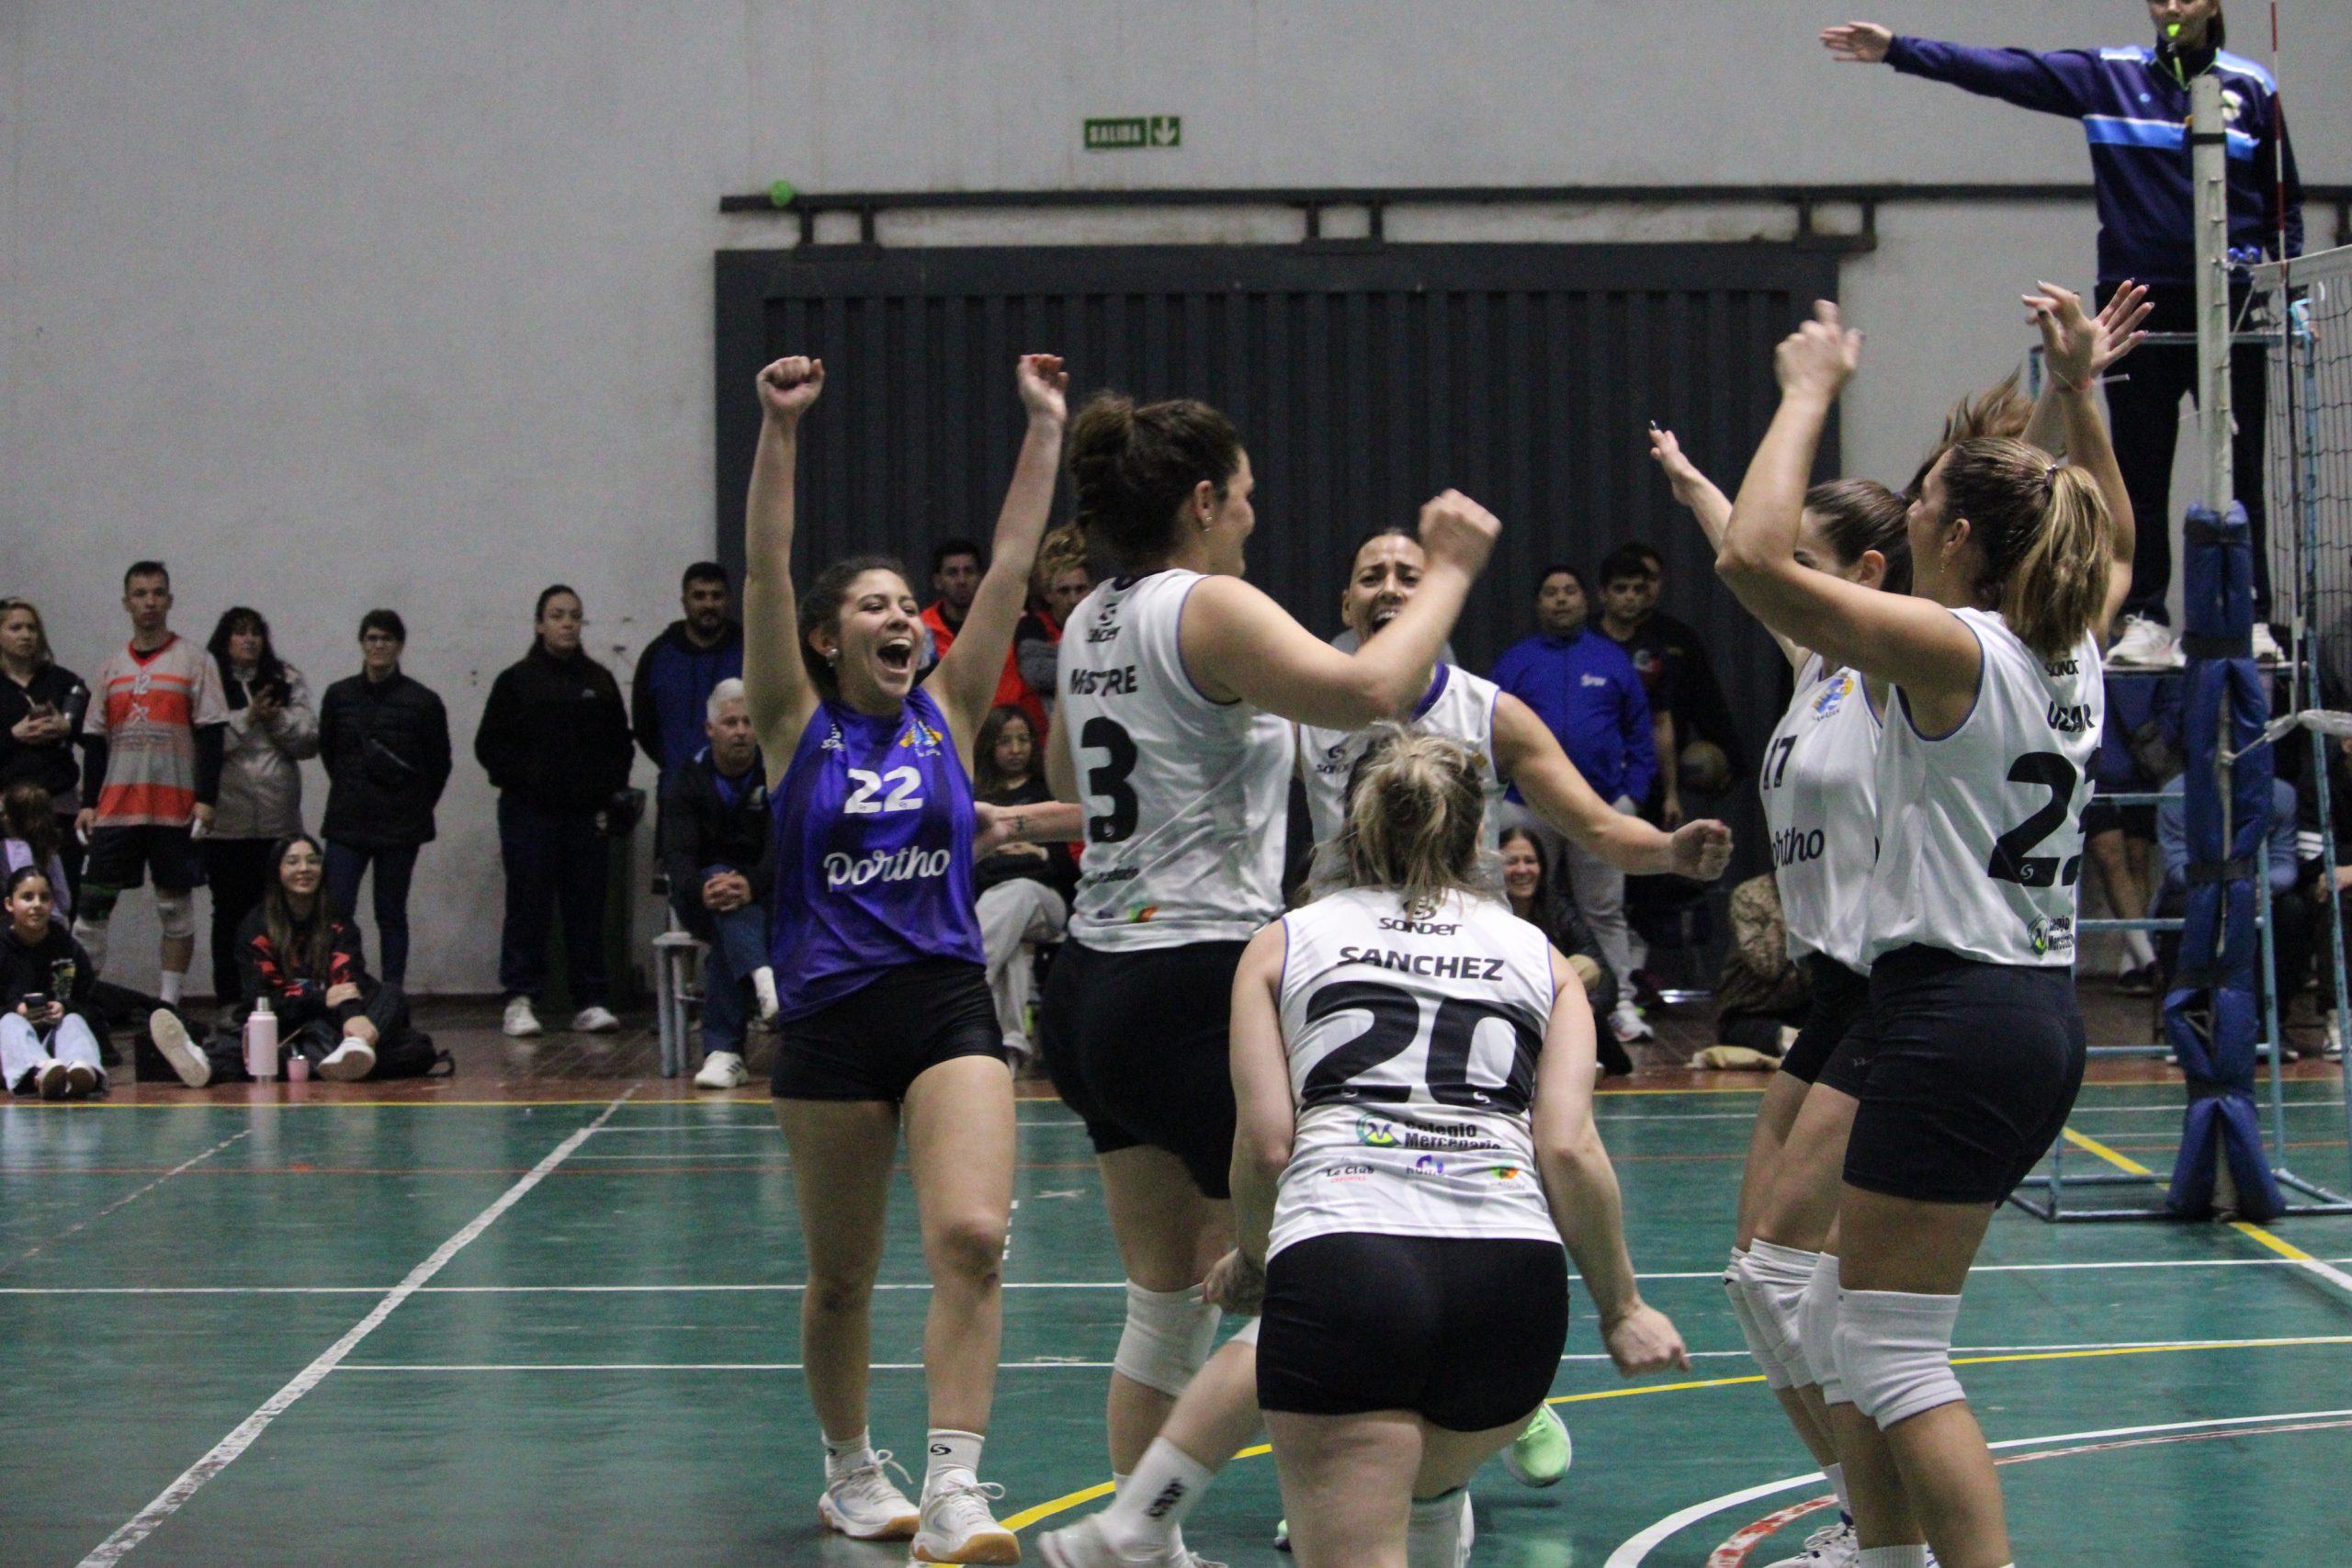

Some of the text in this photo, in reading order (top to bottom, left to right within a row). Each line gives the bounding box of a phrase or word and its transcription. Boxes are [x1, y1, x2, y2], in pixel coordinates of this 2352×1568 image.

[844, 765, 924, 814] 22
[1081, 716, 1138, 842] 3
[1763, 735, 1798, 791] 17
[1338, 946, 1505, 981] SANCHEZ
[1299, 980, 1544, 1113] 20
